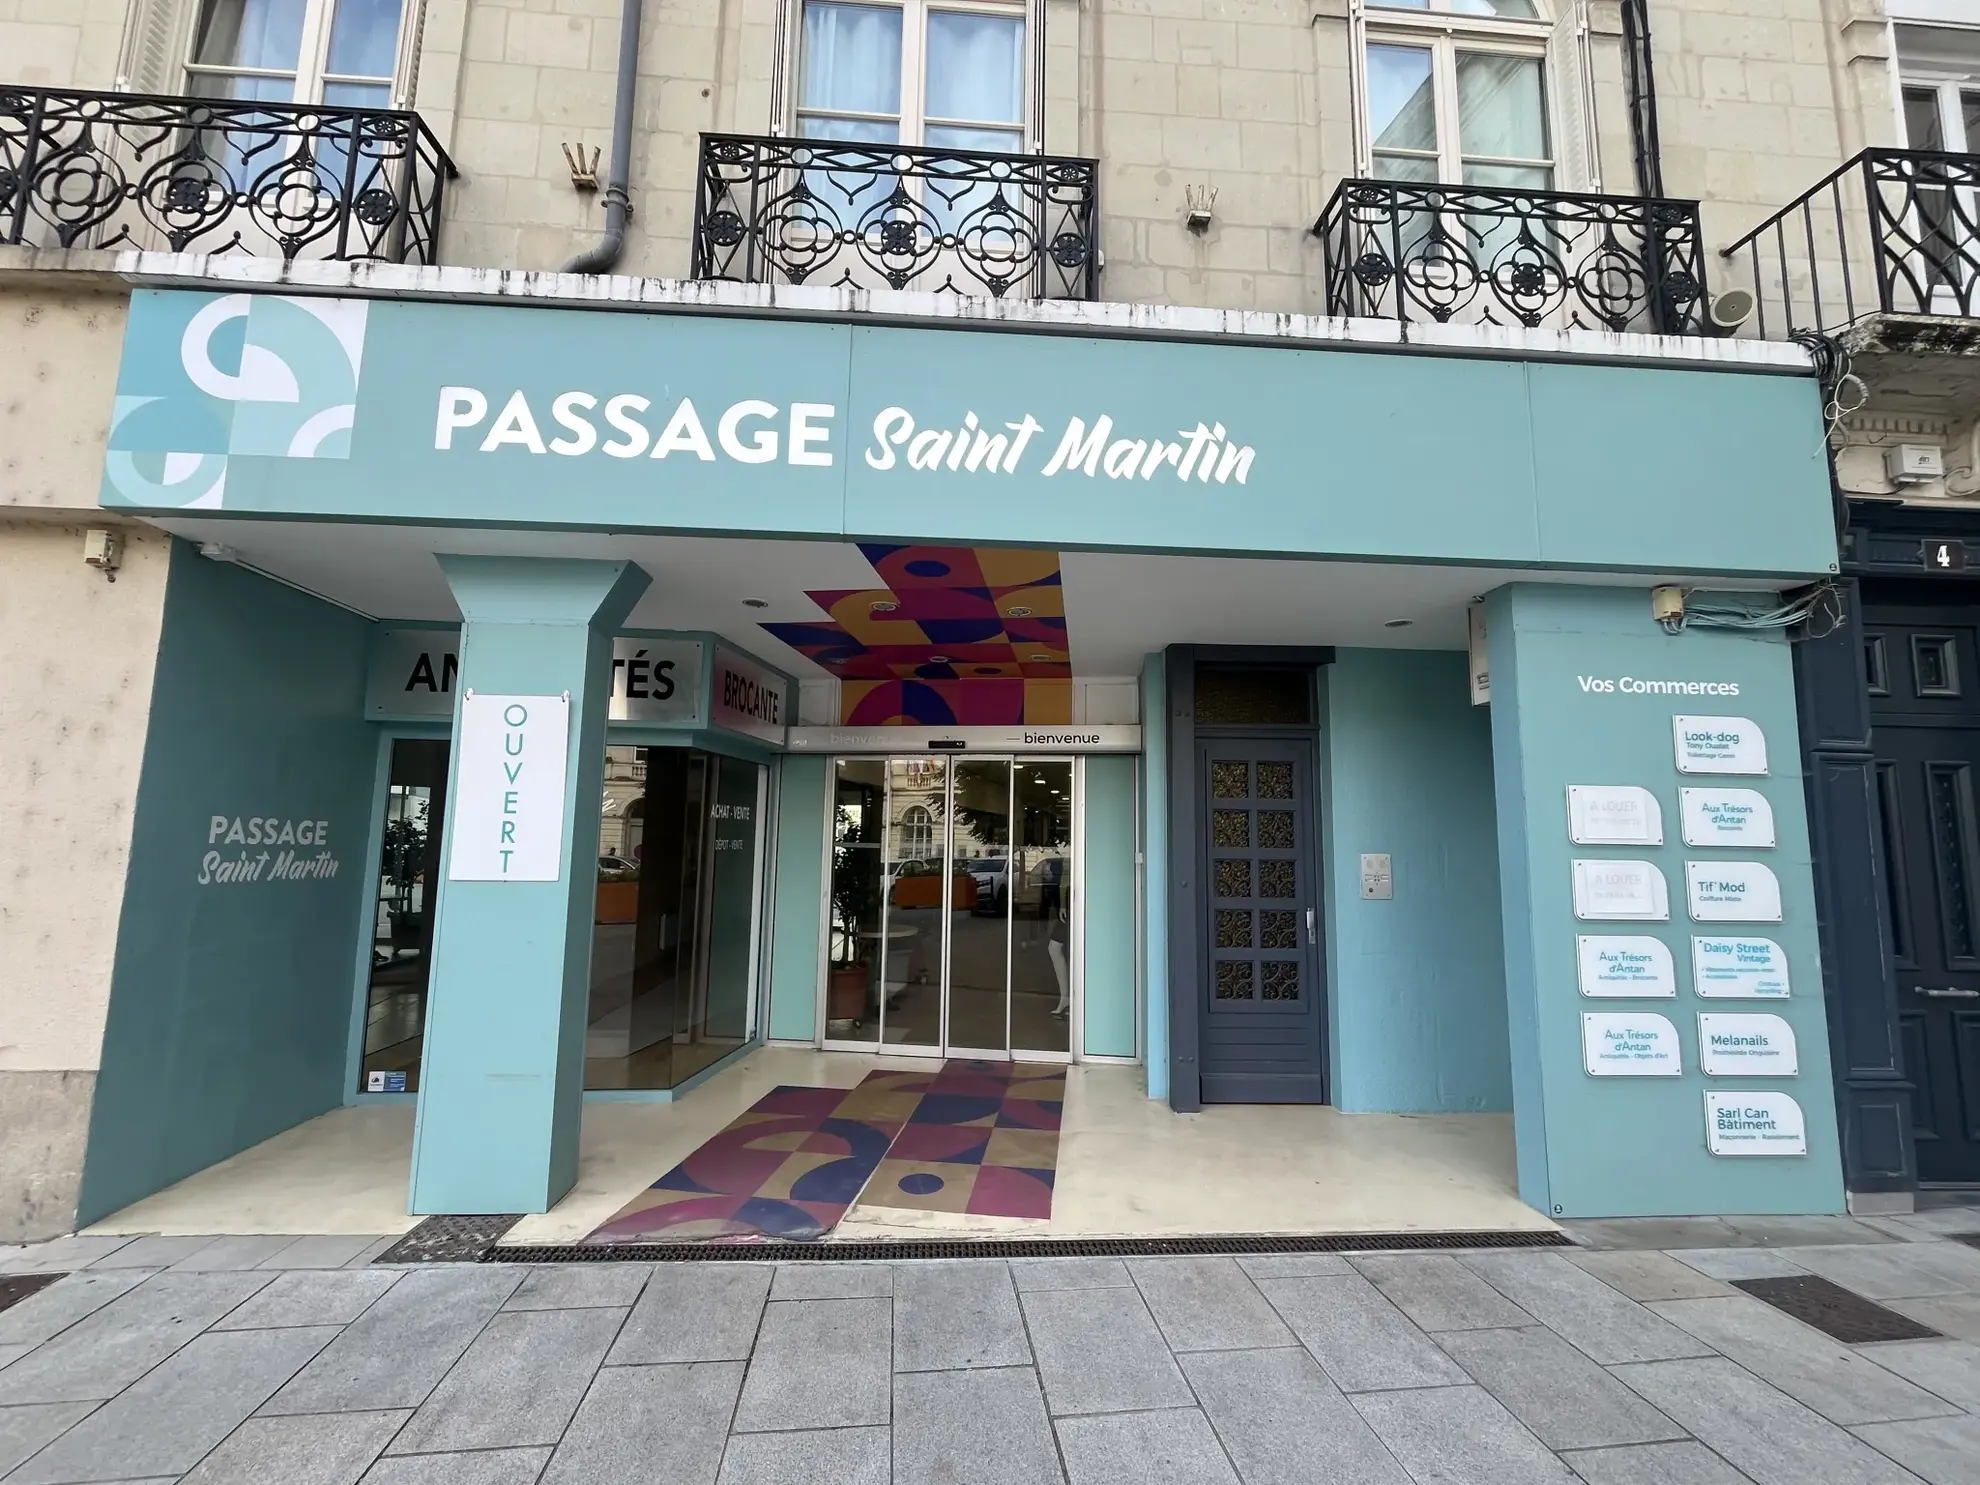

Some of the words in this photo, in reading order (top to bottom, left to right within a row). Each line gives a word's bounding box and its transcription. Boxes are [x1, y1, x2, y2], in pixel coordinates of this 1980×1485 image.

[434, 384, 836, 467] PASSAGE
[864, 405, 1045, 475] Saint
[1040, 413, 1256, 485] Martin
[1936, 545, 1950, 567] 4
[1577, 675, 1615, 693] Vos
[1618, 676, 1740, 696] Commerces
[724, 670, 779, 724] BROCANTE
[1023, 731, 1100, 745] bienvenue
[1684, 731, 1740, 744] Look-dog
[499, 704, 527, 873] OUVERT
[710, 804, 730, 819] ACHAT
[733, 807, 750, 820] VENTE
[1701, 803, 1720, 813] Aux
[1721, 803, 1753, 813] Trésors
[1711, 814, 1746, 824] d'Antan
[208, 815, 329, 845] PASSAGE
[198, 850, 270, 885] Saint
[266, 850, 339, 881] Martin
[1719, 882, 1745, 892] Mod
[1703, 942, 1733, 955] Daisy
[1736, 943, 1771, 953] Street
[1599, 951, 1618, 961] Aux
[1619, 951, 1652, 962] Trésors
[1736, 954, 1771, 964] Vintage
[1609, 962, 1645, 973] d'Antan
[1604, 1029, 1624, 1040] Aux
[1625, 1029, 1659, 1040] Trésors
[1710, 1034, 1769, 1046] Melanails
[1614, 1041, 1651, 1051] d'Antan
[1717, 1107, 1741, 1119] Sarl
[1744, 1107, 1769, 1119] Can
[1718, 1119, 1776, 1130] Bâtiment
